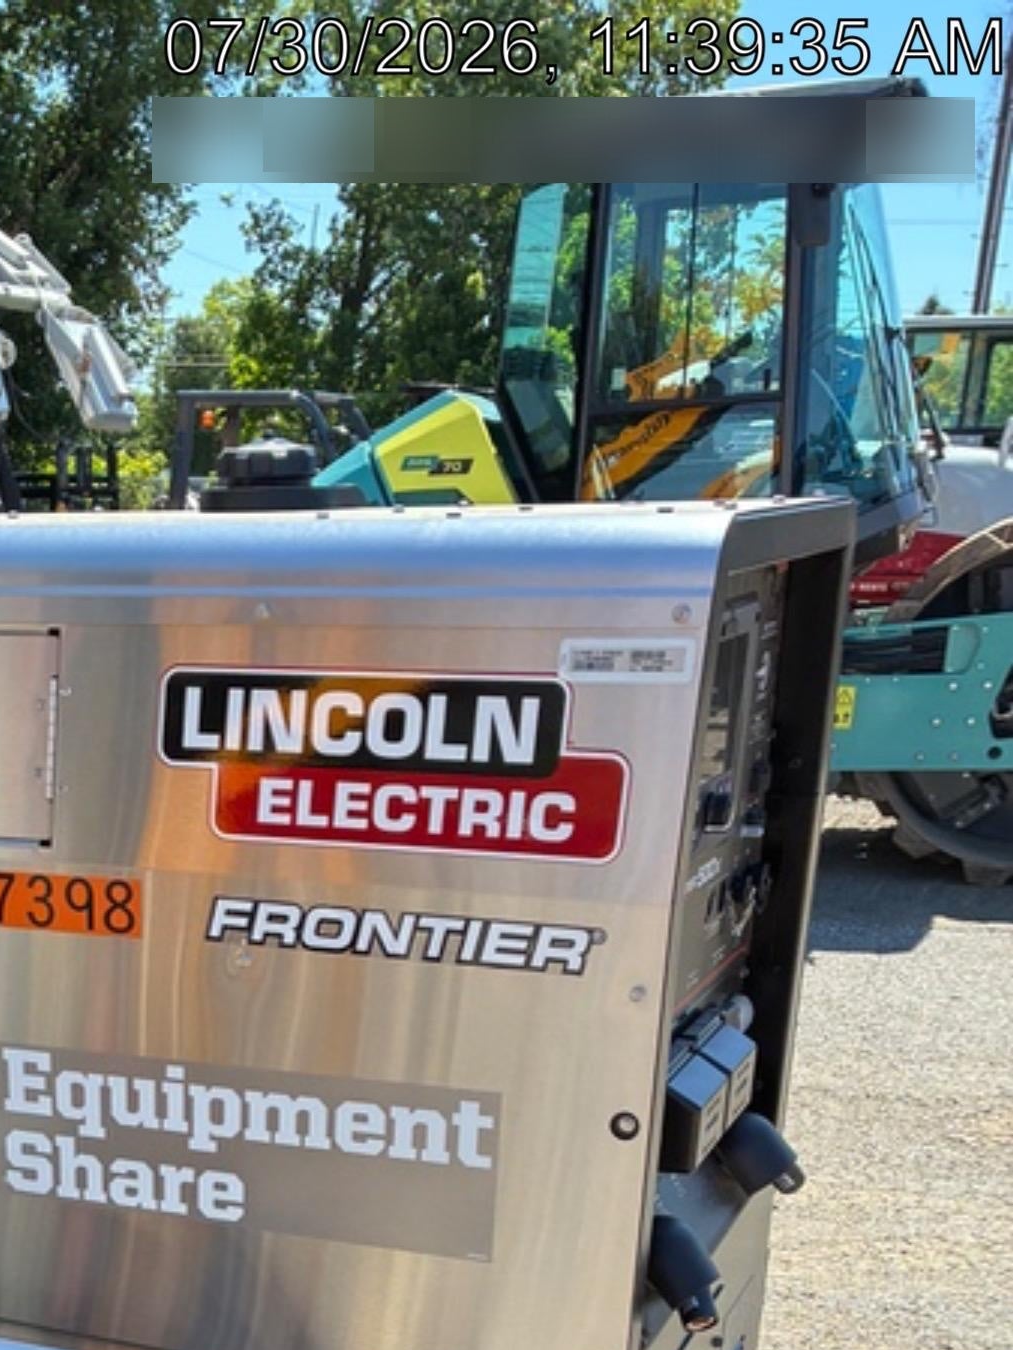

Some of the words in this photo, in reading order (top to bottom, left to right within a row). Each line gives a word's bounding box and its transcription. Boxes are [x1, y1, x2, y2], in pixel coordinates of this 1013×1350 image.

[181, 686, 541, 765] LINCOLN
[256, 776, 577, 844] ELECTRIC
[206, 896, 595, 975] FRONTIER
[1, 1047, 495, 1169] Equipment
[3, 1129, 246, 1222] Share
